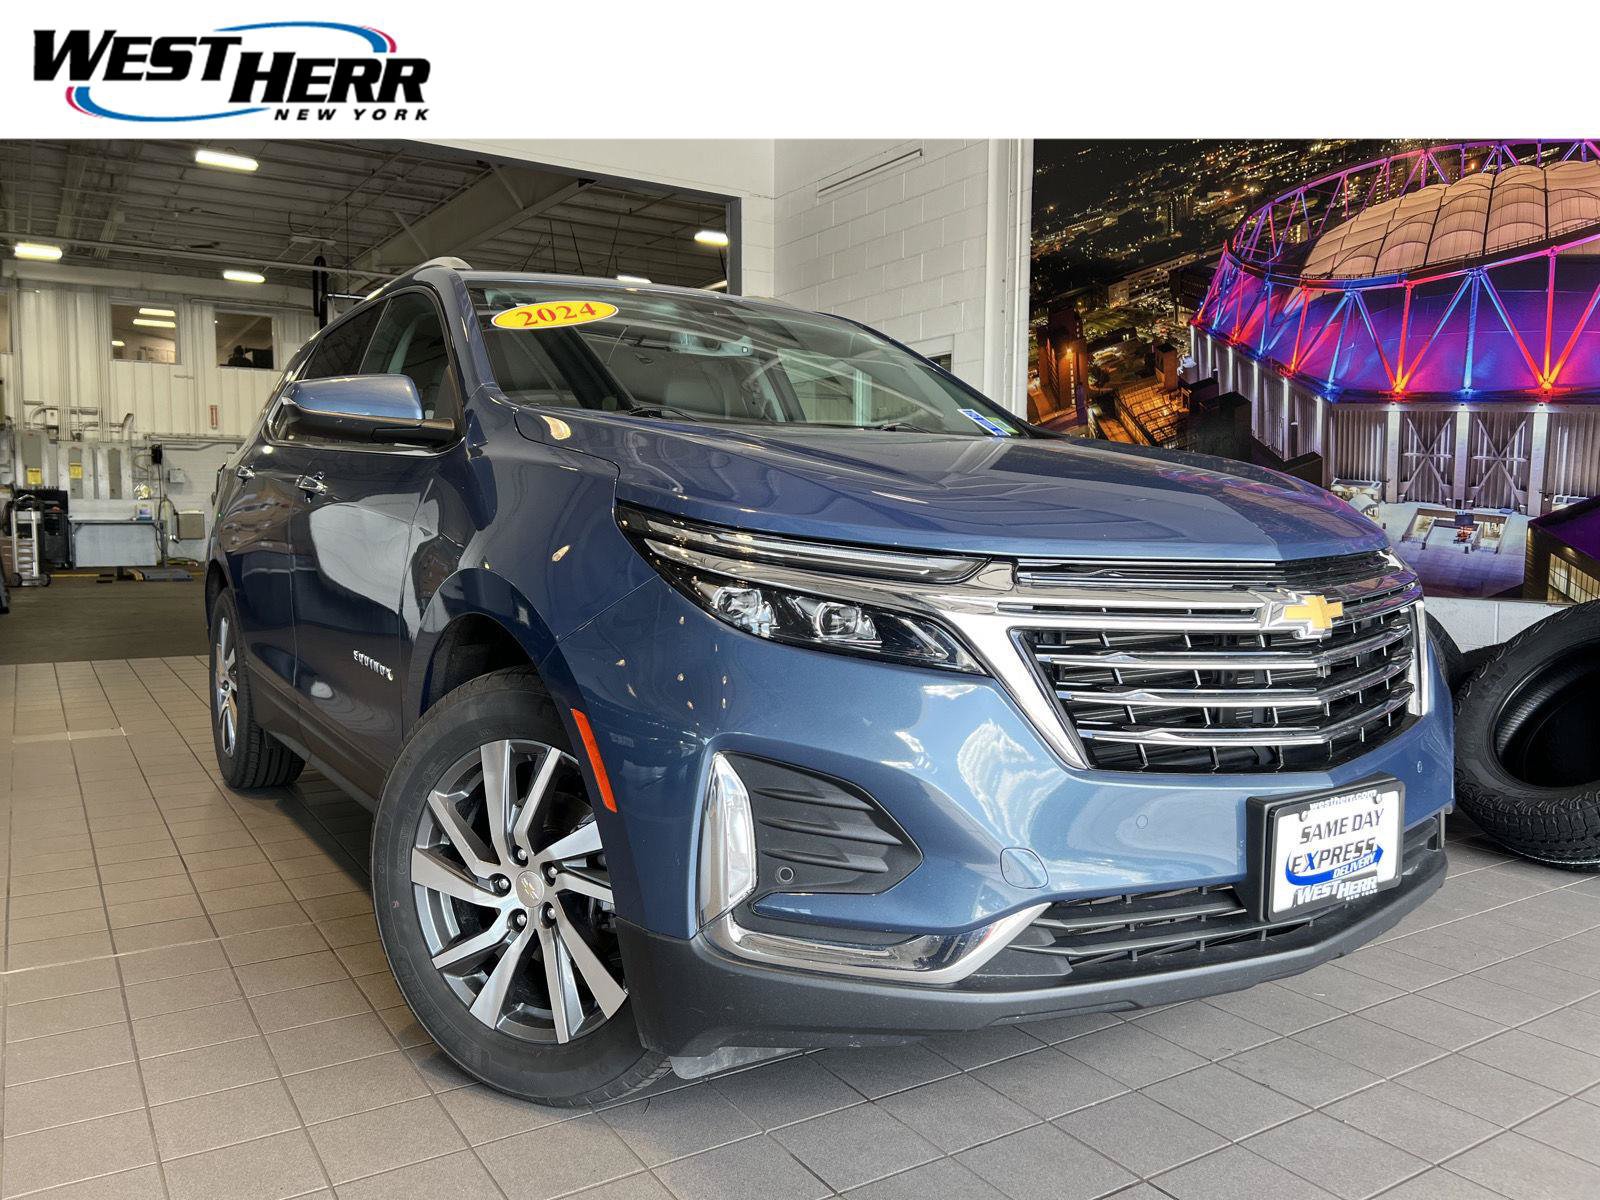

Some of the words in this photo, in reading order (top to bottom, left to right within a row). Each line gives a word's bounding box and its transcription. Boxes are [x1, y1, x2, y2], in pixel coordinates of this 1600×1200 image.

[516, 303, 596, 326] 2024
[1300, 817, 1349, 844] SAME
[1352, 808, 1385, 832] DAY
[1291, 838, 1376, 874] EXPRESS
[1333, 853, 1375, 879] DELIVERY
[1296, 880, 1341, 905] WEST
[1337, 876, 1377, 899] HERR
